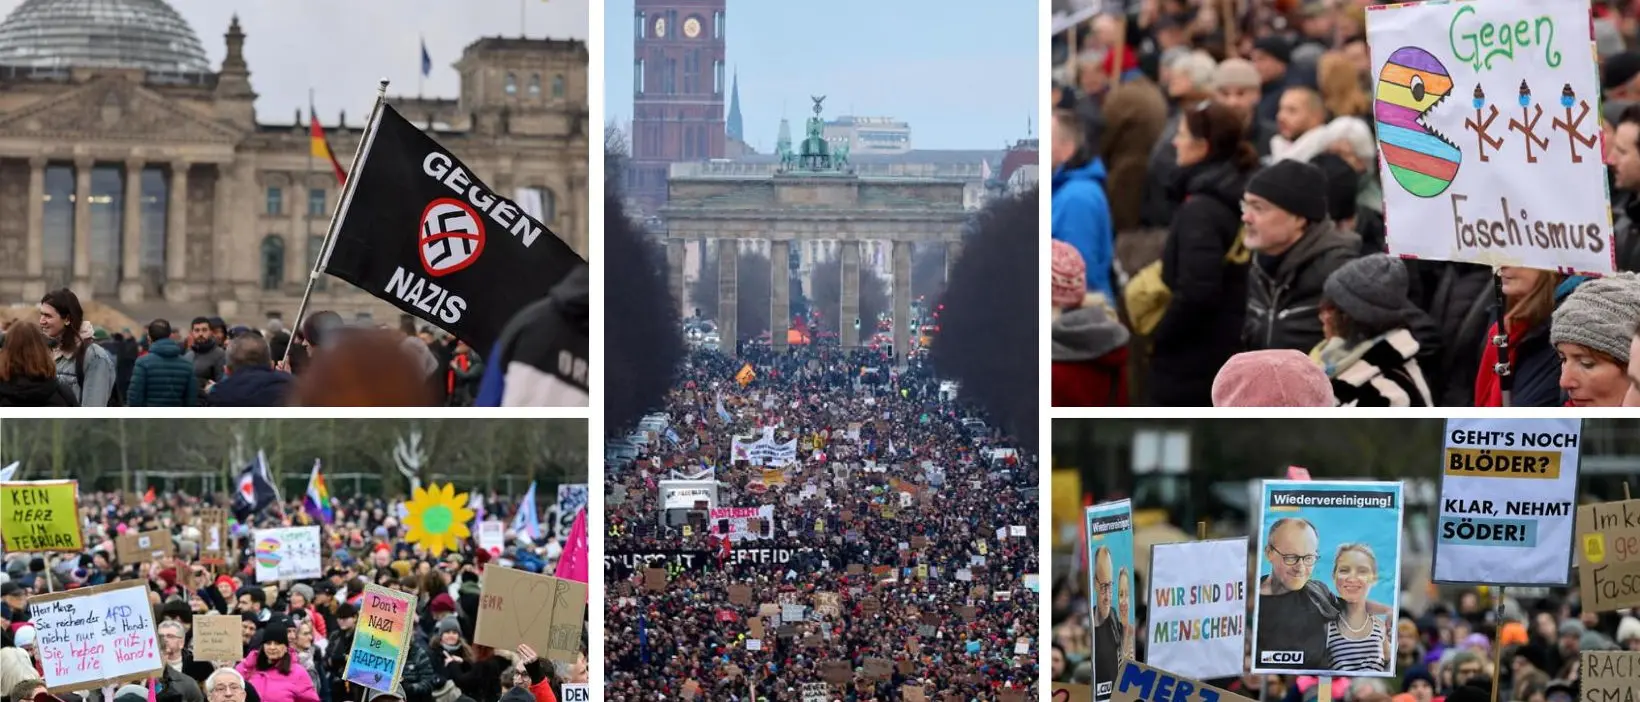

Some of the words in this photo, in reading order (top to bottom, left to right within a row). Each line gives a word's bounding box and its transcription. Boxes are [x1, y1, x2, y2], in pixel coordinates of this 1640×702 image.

[1450, 5, 1562, 73] Gegen
[422, 151, 542, 248] GEGEN
[1451, 193, 1605, 253] Faschismus
[383, 266, 467, 324] NAZIS
[1451, 429, 1515, 447] GEHT'S
[1521, 432, 1578, 448] NOCH
[1449, 449, 1550, 474] BLÖDER?
[11, 489, 49, 505] KEIN
[1273, 494, 1392, 508] Wiedervereinigung!
[1444, 499, 1498, 517] KLAR,
[1505, 501, 1571, 516] NEHMT
[13, 508, 53, 522] MERZ
[1593, 505, 1617, 530] Im
[31, 524, 47, 537] IM
[1442, 518, 1526, 542] SÖDER!
[371, 596, 398, 614] Don't
[1155, 587, 1186, 607] WIR
[1190, 583, 1221, 605] SIND
[1226, 581, 1244, 601] DIE
[32, 606, 50, 617] Herr
[36, 619, 51, 631] Sie
[86, 610, 100, 623] der
[106, 605, 132, 622] AfD
[42, 629, 70, 645] nicht
[76, 632, 95, 642] nur
[101, 621, 117, 637] die
[368, 615, 394, 632] NAZI
[1154, 614, 1243, 643] MENSCHEN!
[44, 646, 64, 660] Sie
[70, 640, 104, 658] heben
[369, 635, 382, 648] be
[55, 662, 69, 677] ihr
[77, 656, 101, 672] die
[352, 650, 396, 674] HAPPY!
[1272, 652, 1302, 662] CDU
[1588, 654, 1640, 678] RACI
